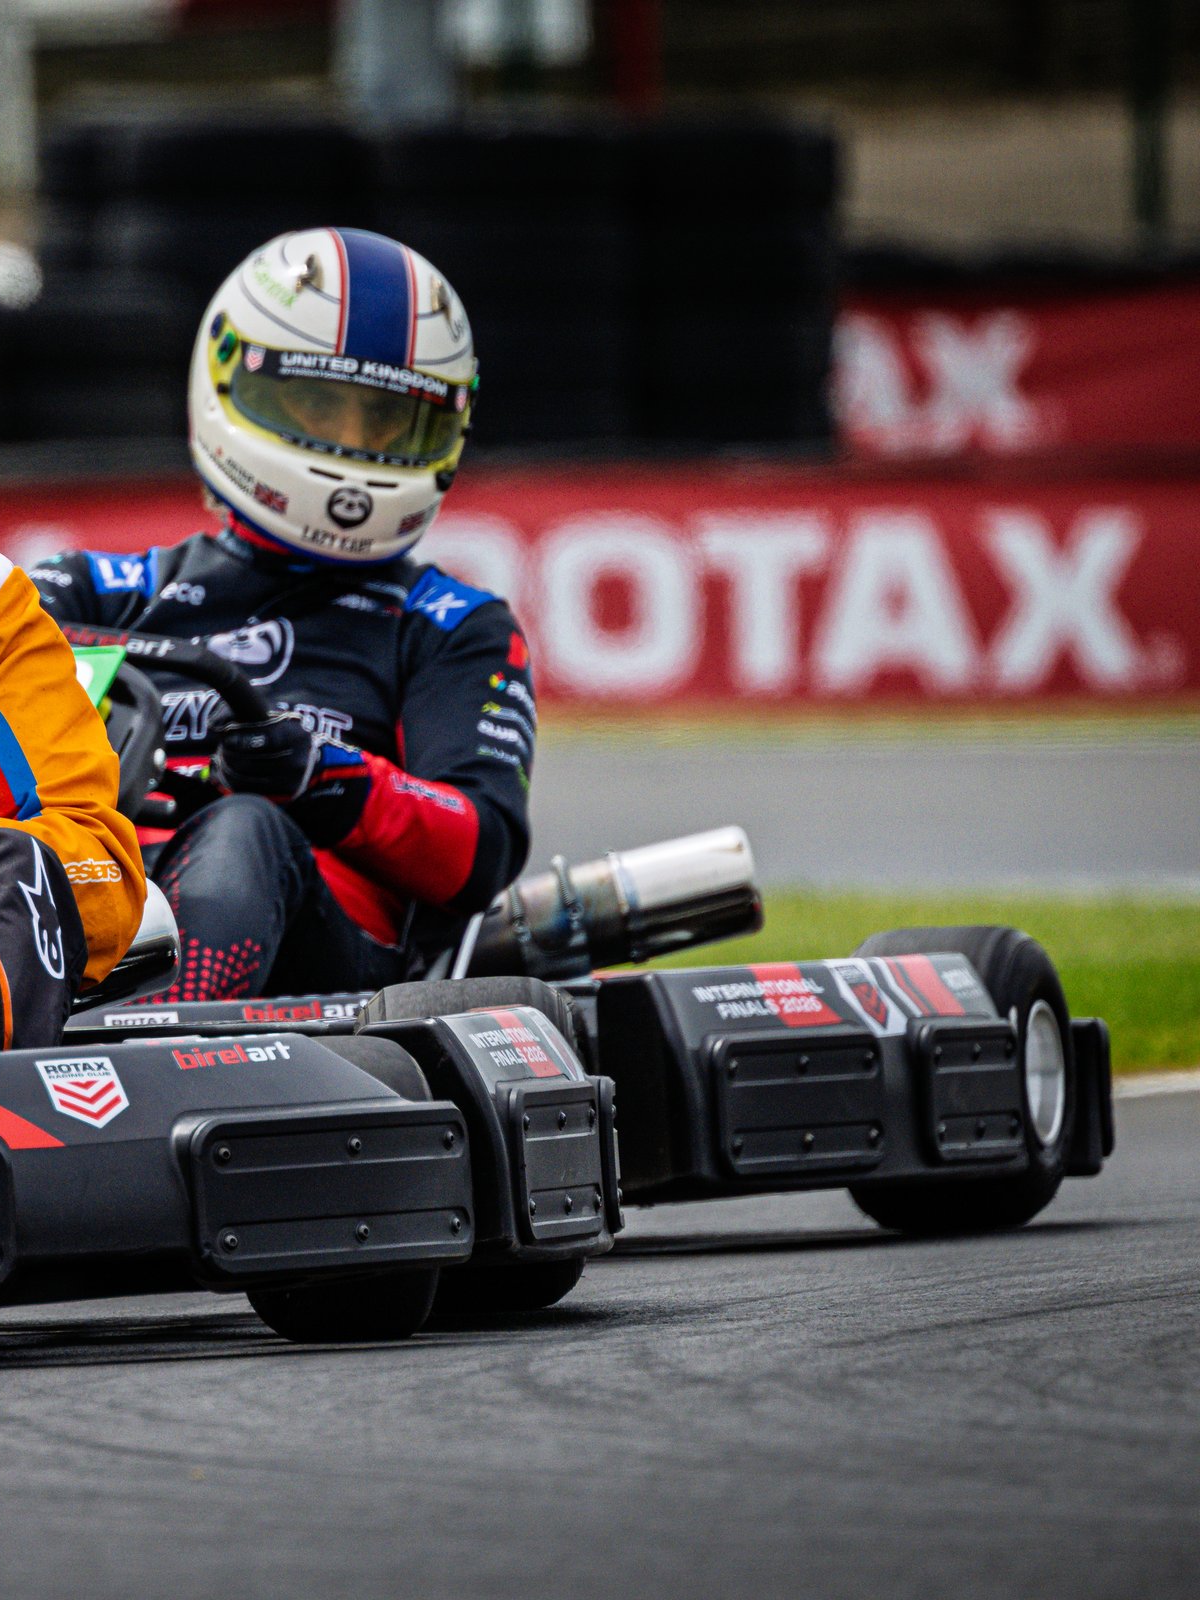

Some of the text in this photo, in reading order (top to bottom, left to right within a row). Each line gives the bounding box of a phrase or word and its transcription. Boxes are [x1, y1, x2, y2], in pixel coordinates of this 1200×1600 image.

[280, 352, 358, 374] UNITED
[363, 361, 448, 397] KINGDOM
[692, 978, 824, 1003] INTERNATIONAL
[716, 995, 823, 1020] FINALS 2026
[469, 1027, 540, 1049] INTERNATIONAL
[44, 1061, 109, 1074] ROTAX
[172, 1041, 290, 1070] birelart
[490, 1046, 548, 1067] FINALS 2026
